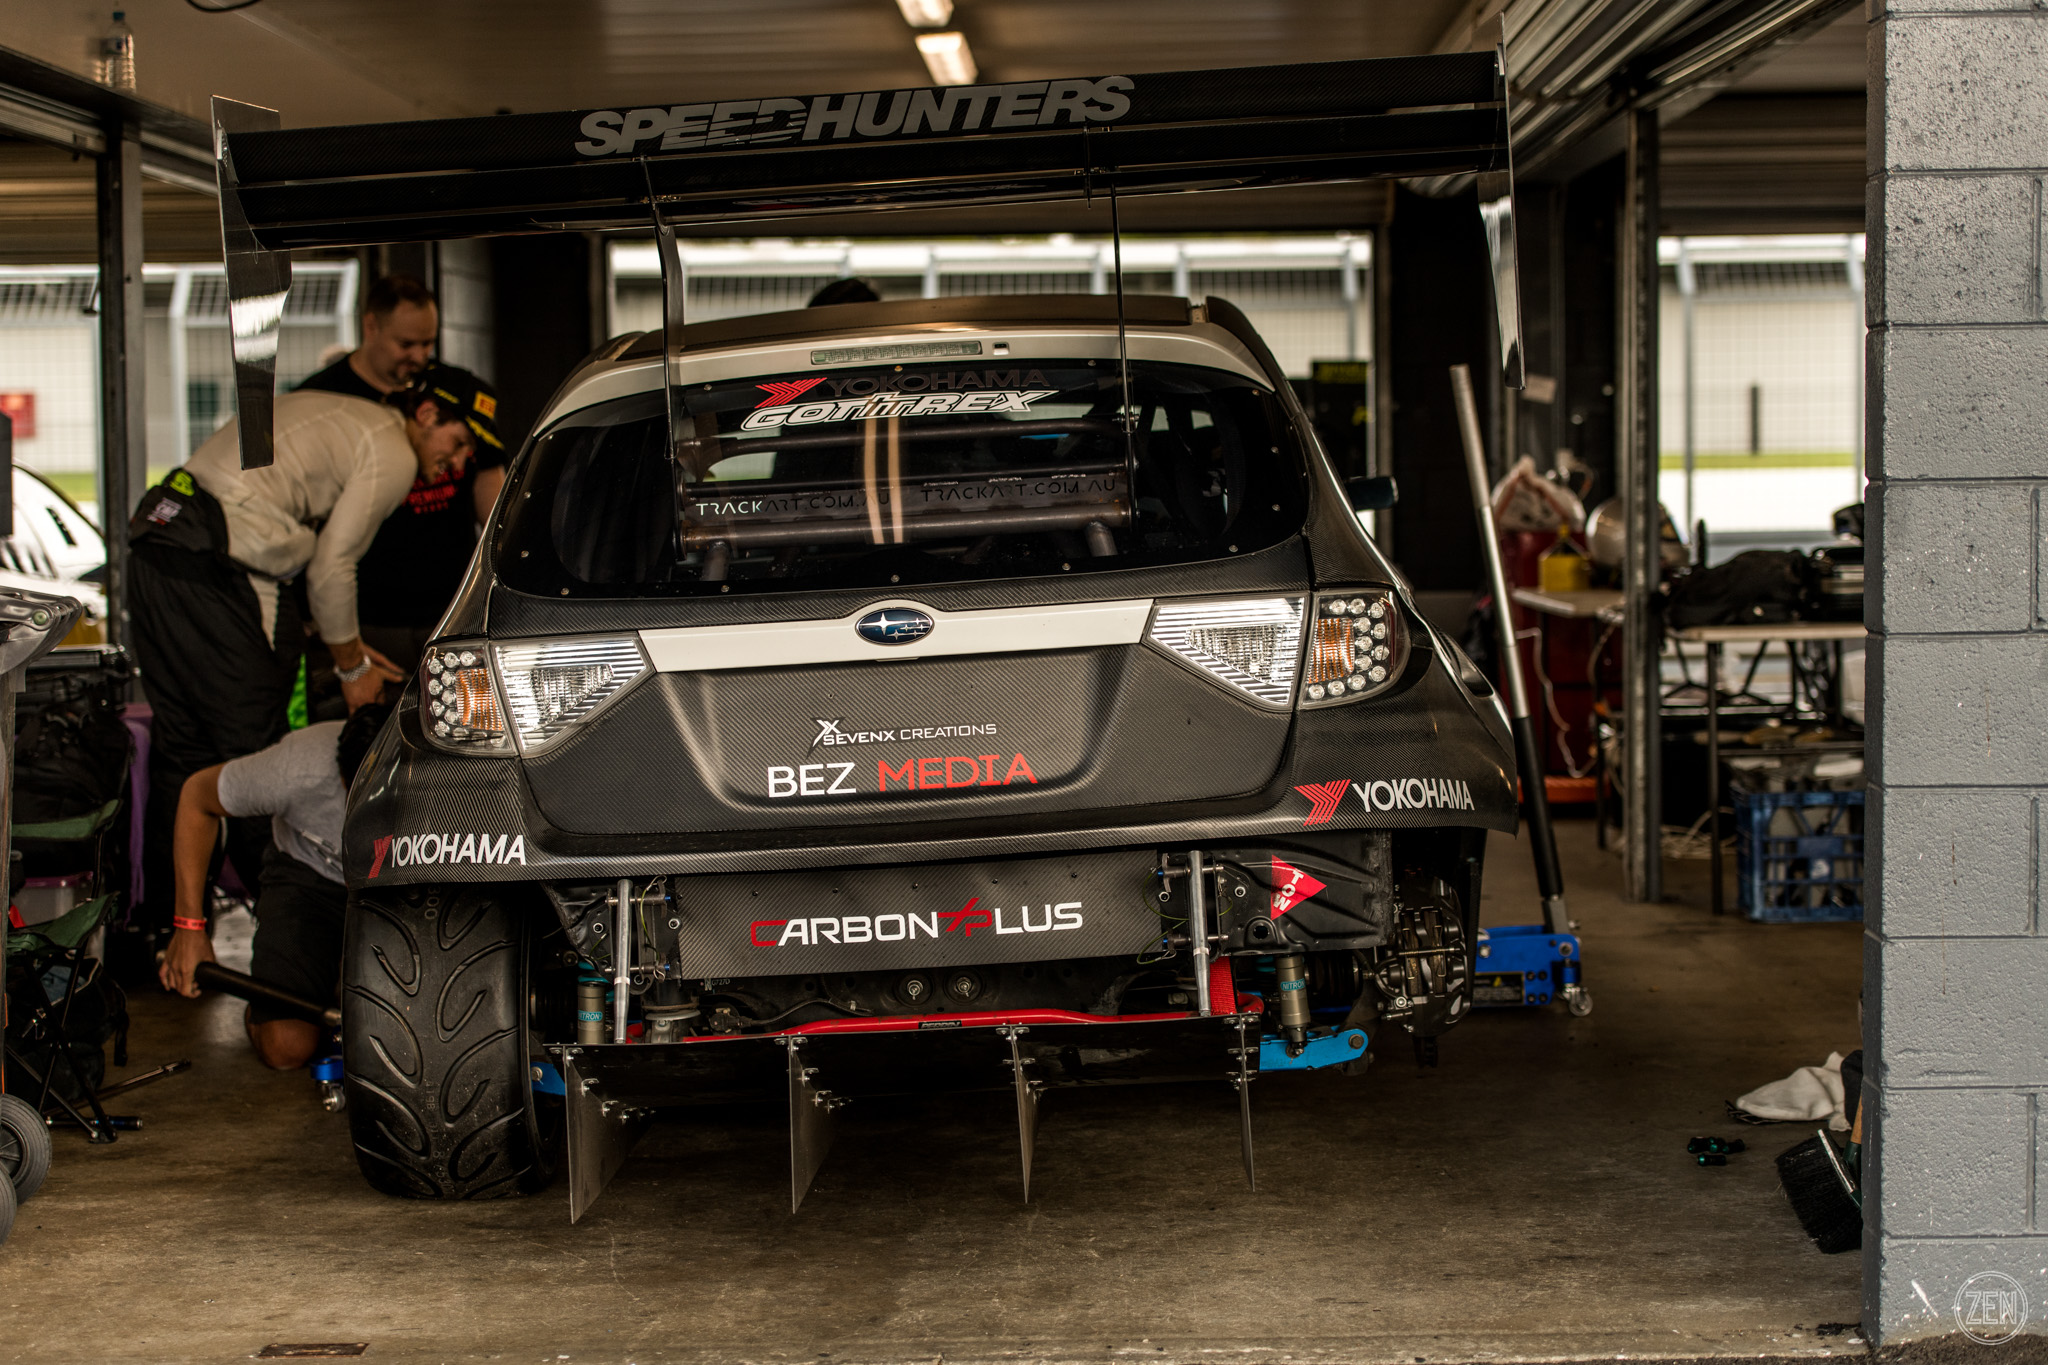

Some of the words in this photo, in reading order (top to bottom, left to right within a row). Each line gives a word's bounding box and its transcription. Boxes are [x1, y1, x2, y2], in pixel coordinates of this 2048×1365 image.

[575, 75, 1136, 157] SPEEDHUNTERS
[825, 368, 1050, 398] YOKOHAMA
[920, 479, 1117, 503] TRACKART.COM.AU
[822, 730, 897, 746] SEVENX
[900, 723, 998, 741] CREATIONS
[767, 762, 857, 798] BEZ
[877, 752, 1039, 792] MEDIA
[1351, 777, 1476, 813] YOKOHAMA
[391, 833, 527, 868] YOKOHAMA
[1273, 869, 1304, 912] TOW
